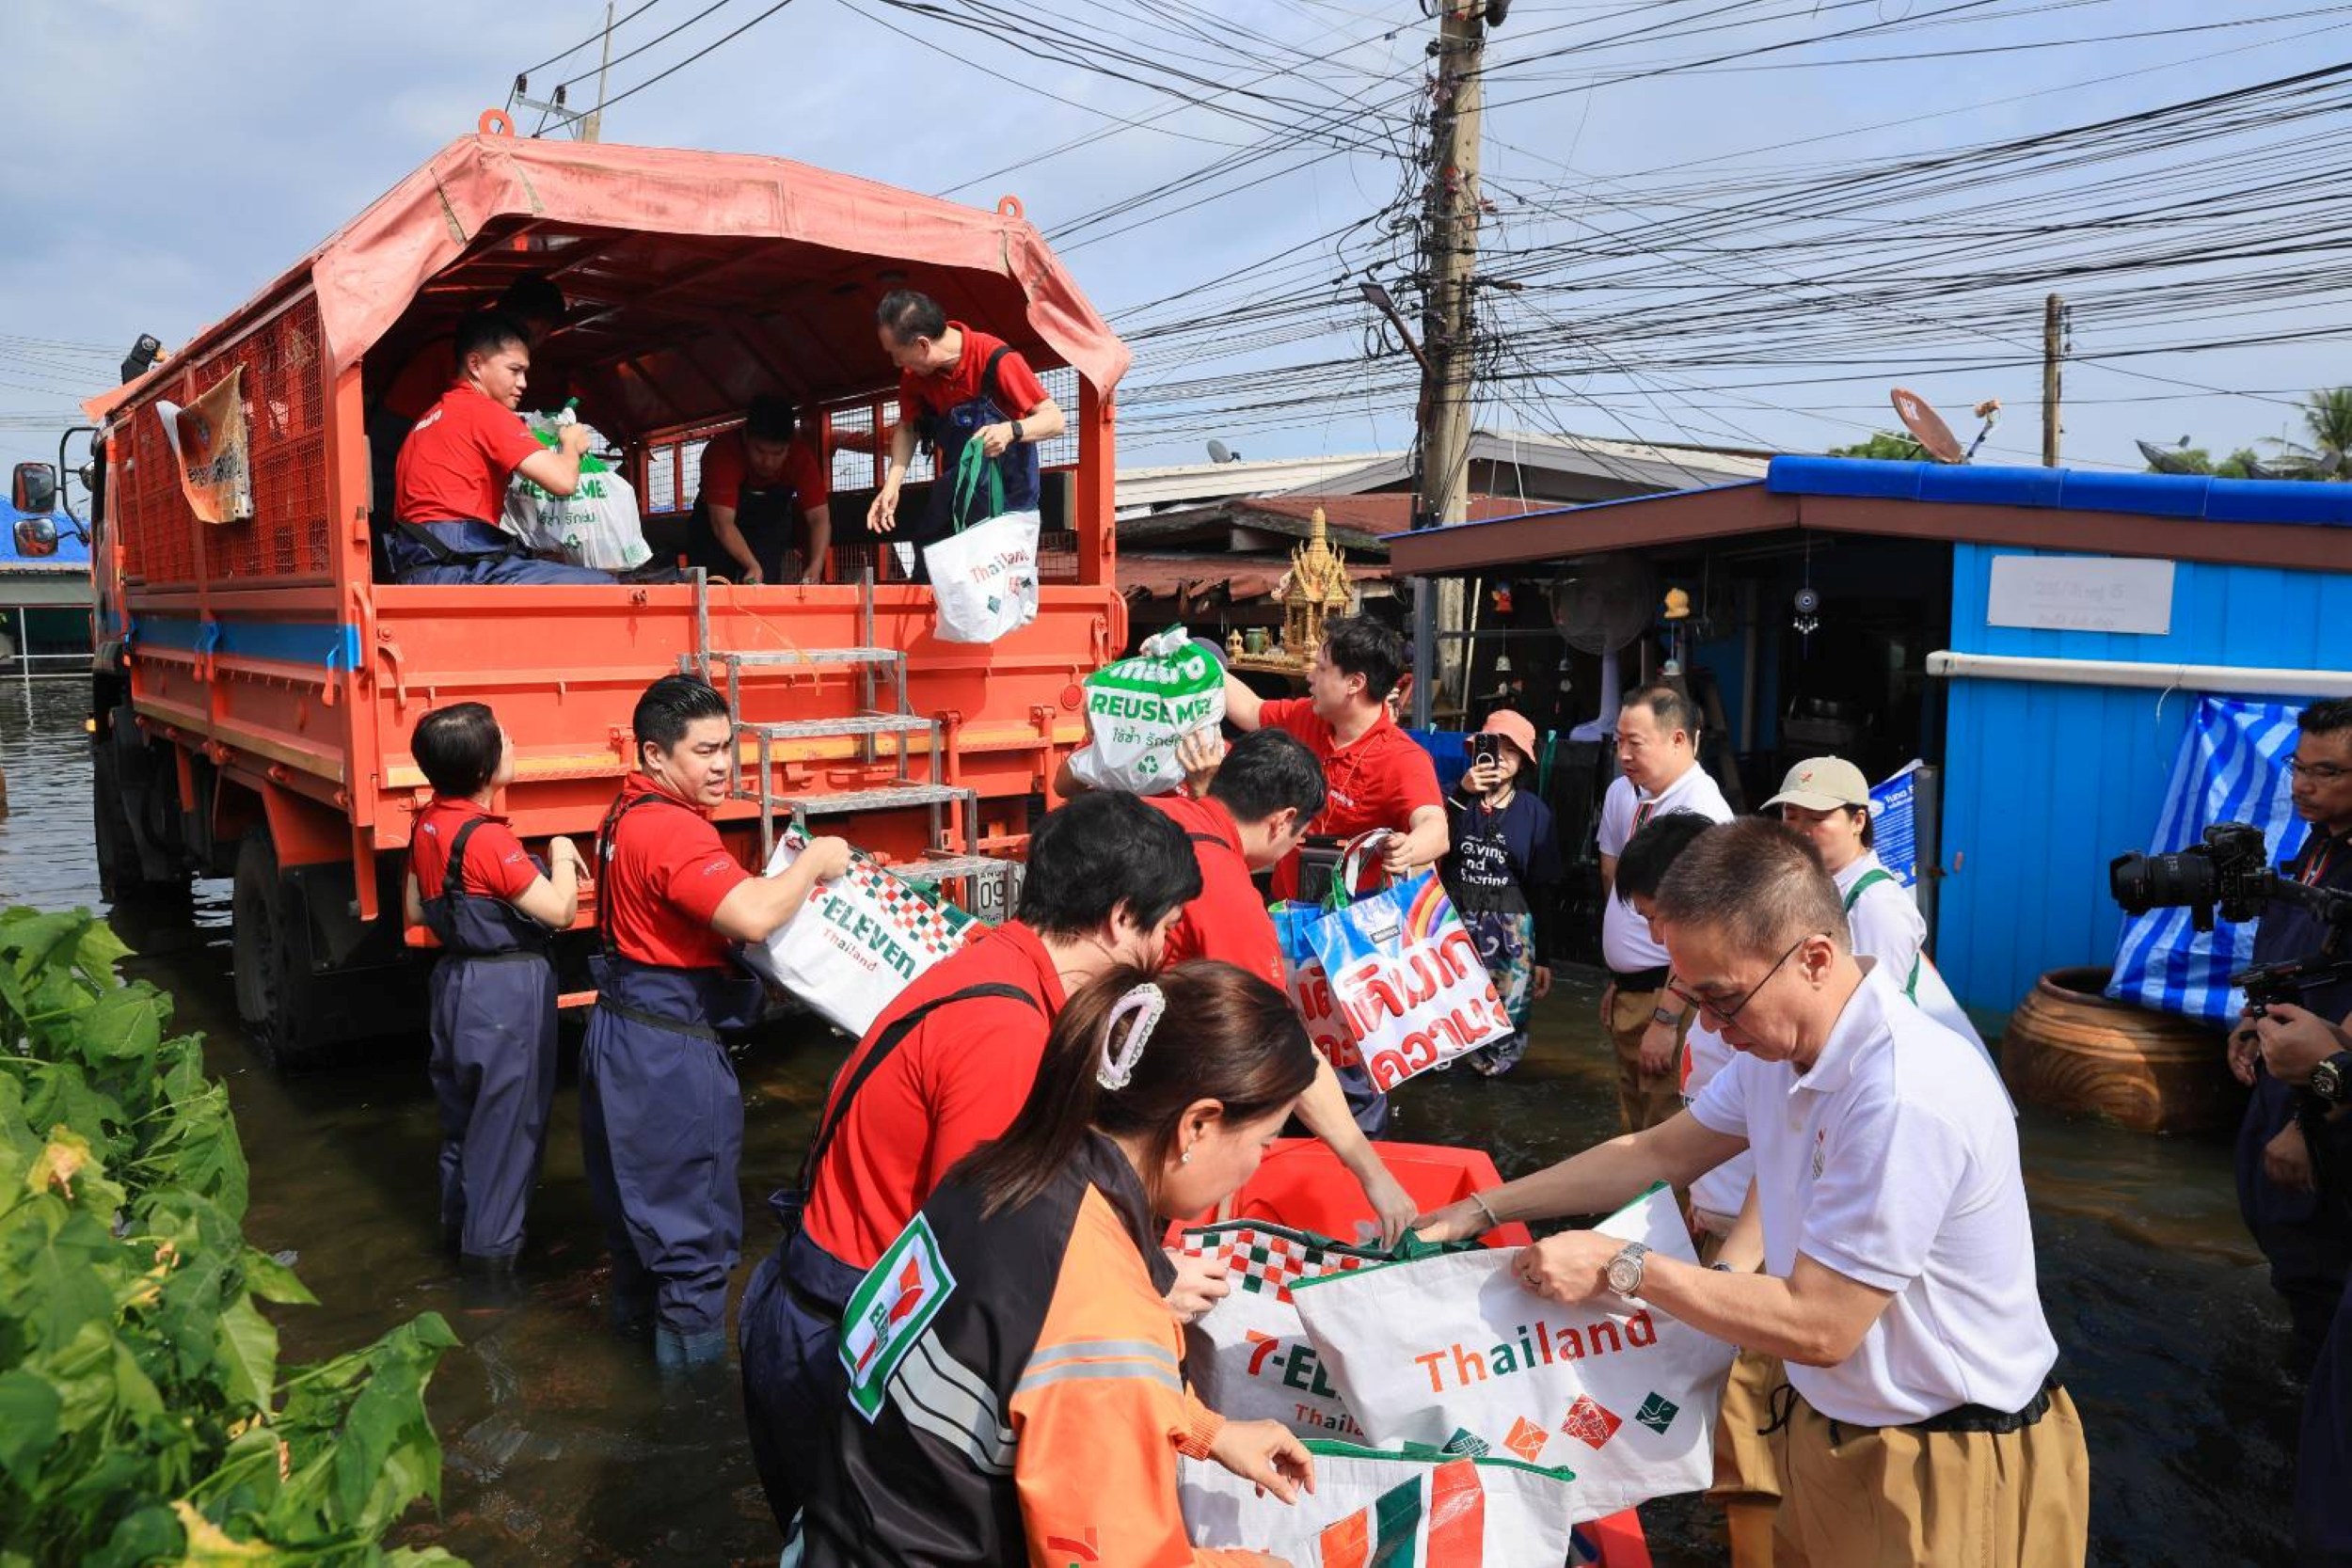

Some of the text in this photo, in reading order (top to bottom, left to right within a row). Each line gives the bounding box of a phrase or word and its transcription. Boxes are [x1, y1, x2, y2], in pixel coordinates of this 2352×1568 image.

[1089, 692, 1173, 724] REUSE
[823, 927, 879, 972] Thailand
[1245, 1328, 1343, 1402] 7-EL
[1415, 1308, 1658, 1393] Thailand
